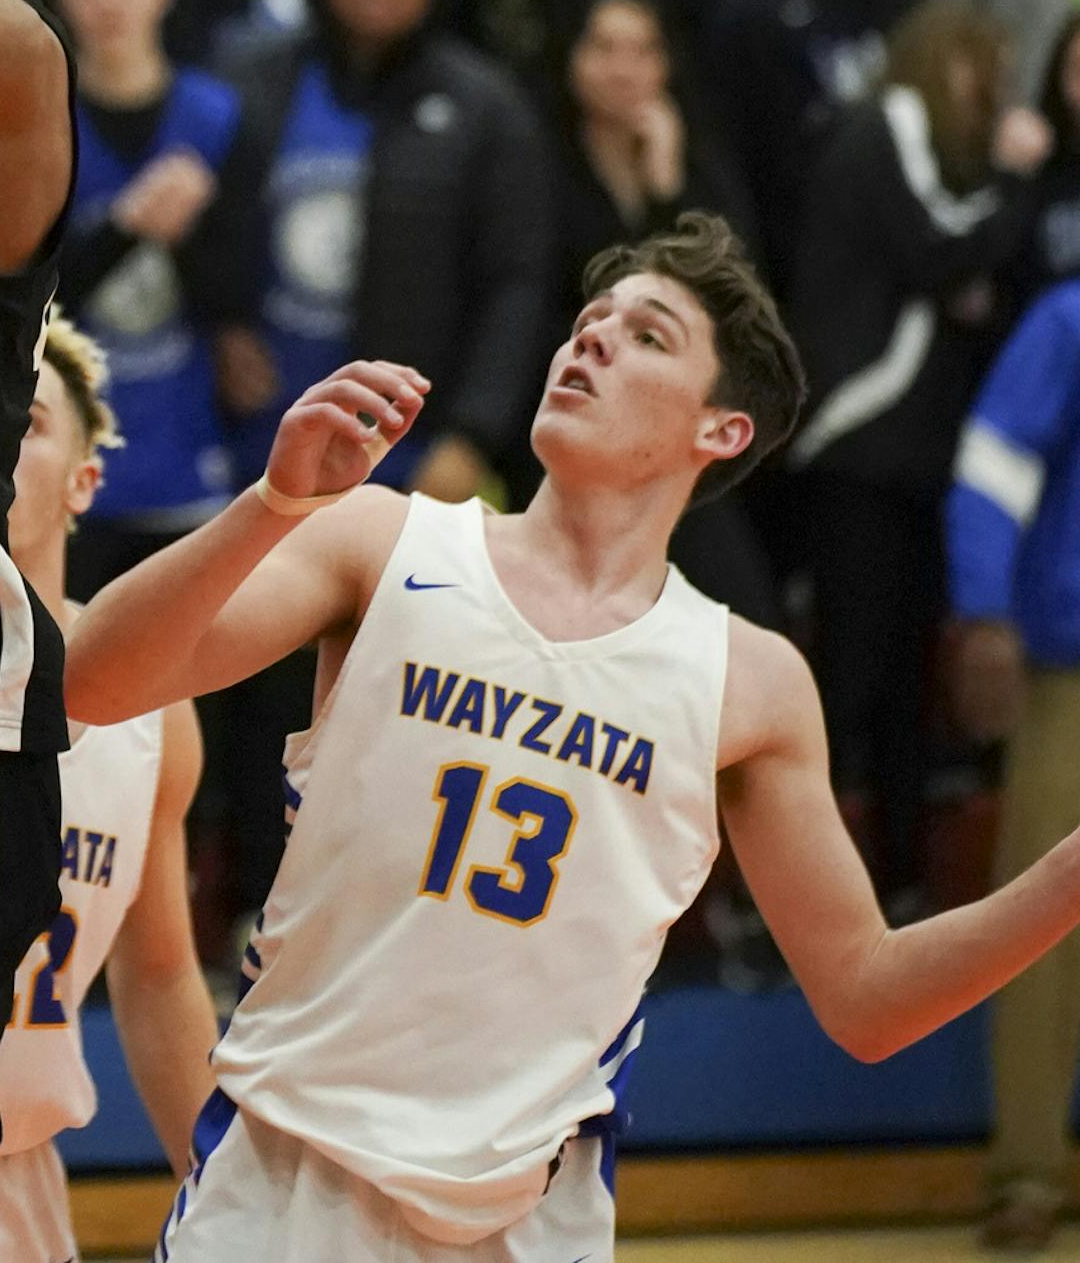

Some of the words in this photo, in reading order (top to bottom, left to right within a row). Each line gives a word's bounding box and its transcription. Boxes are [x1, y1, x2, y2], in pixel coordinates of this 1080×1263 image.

[400, 661, 657, 796] WAYZATA
[417, 760, 580, 929] 13
[8, 904, 80, 1030] 2
